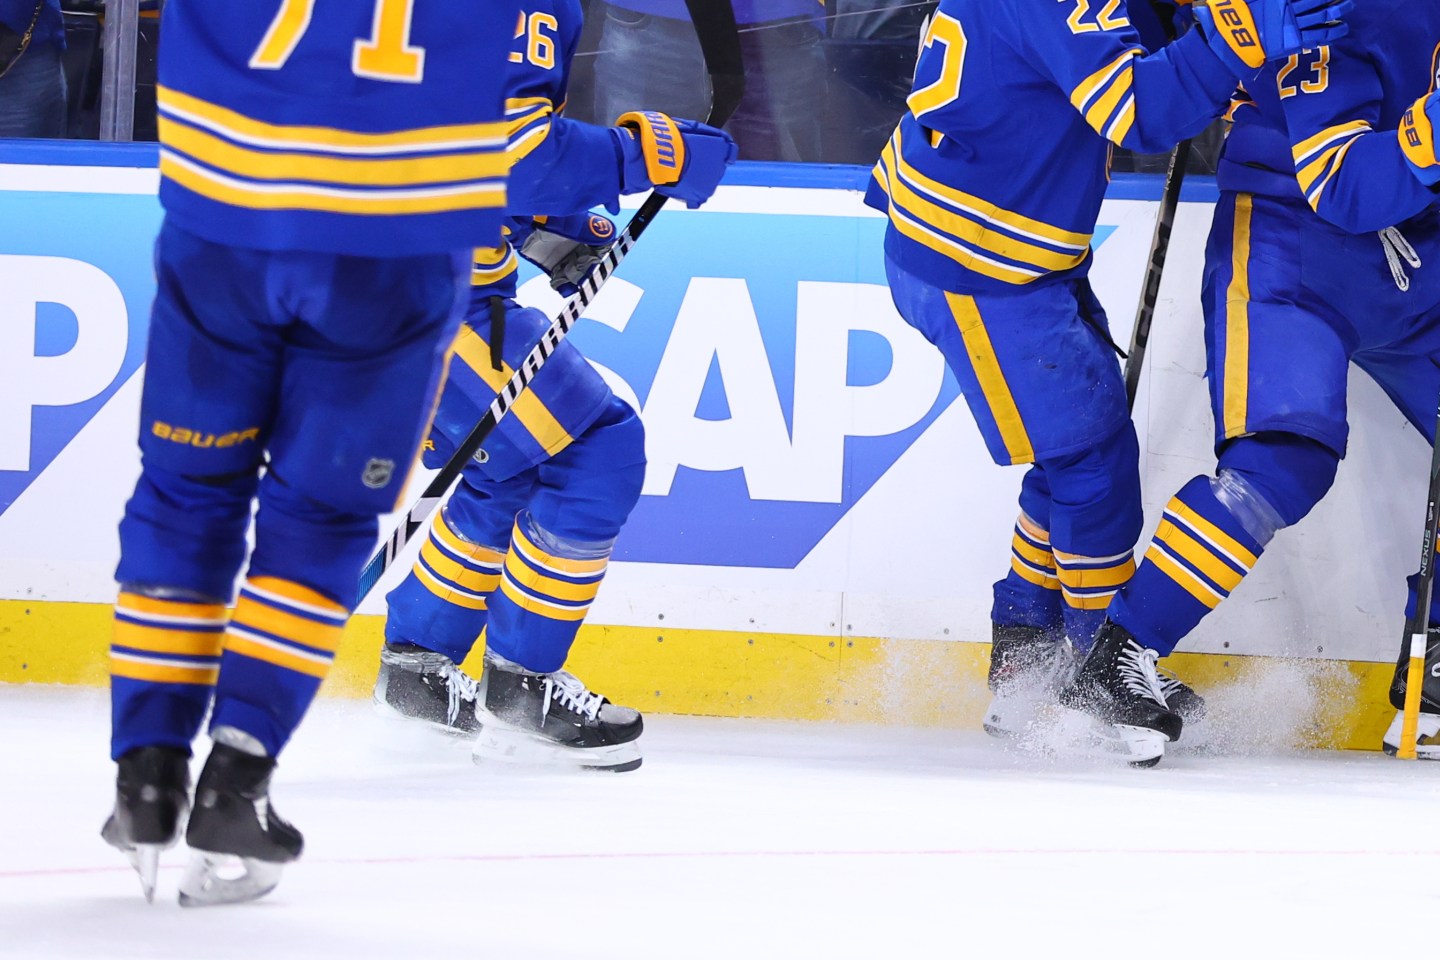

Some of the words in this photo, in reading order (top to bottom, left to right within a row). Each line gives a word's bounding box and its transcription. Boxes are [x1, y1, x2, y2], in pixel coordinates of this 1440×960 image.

[1276, 44, 1331, 100] 23
[490, 235, 635, 424] WARRIOR
[151, 420, 260, 448] BAUER
[1420, 529, 1431, 577] NEXUS
